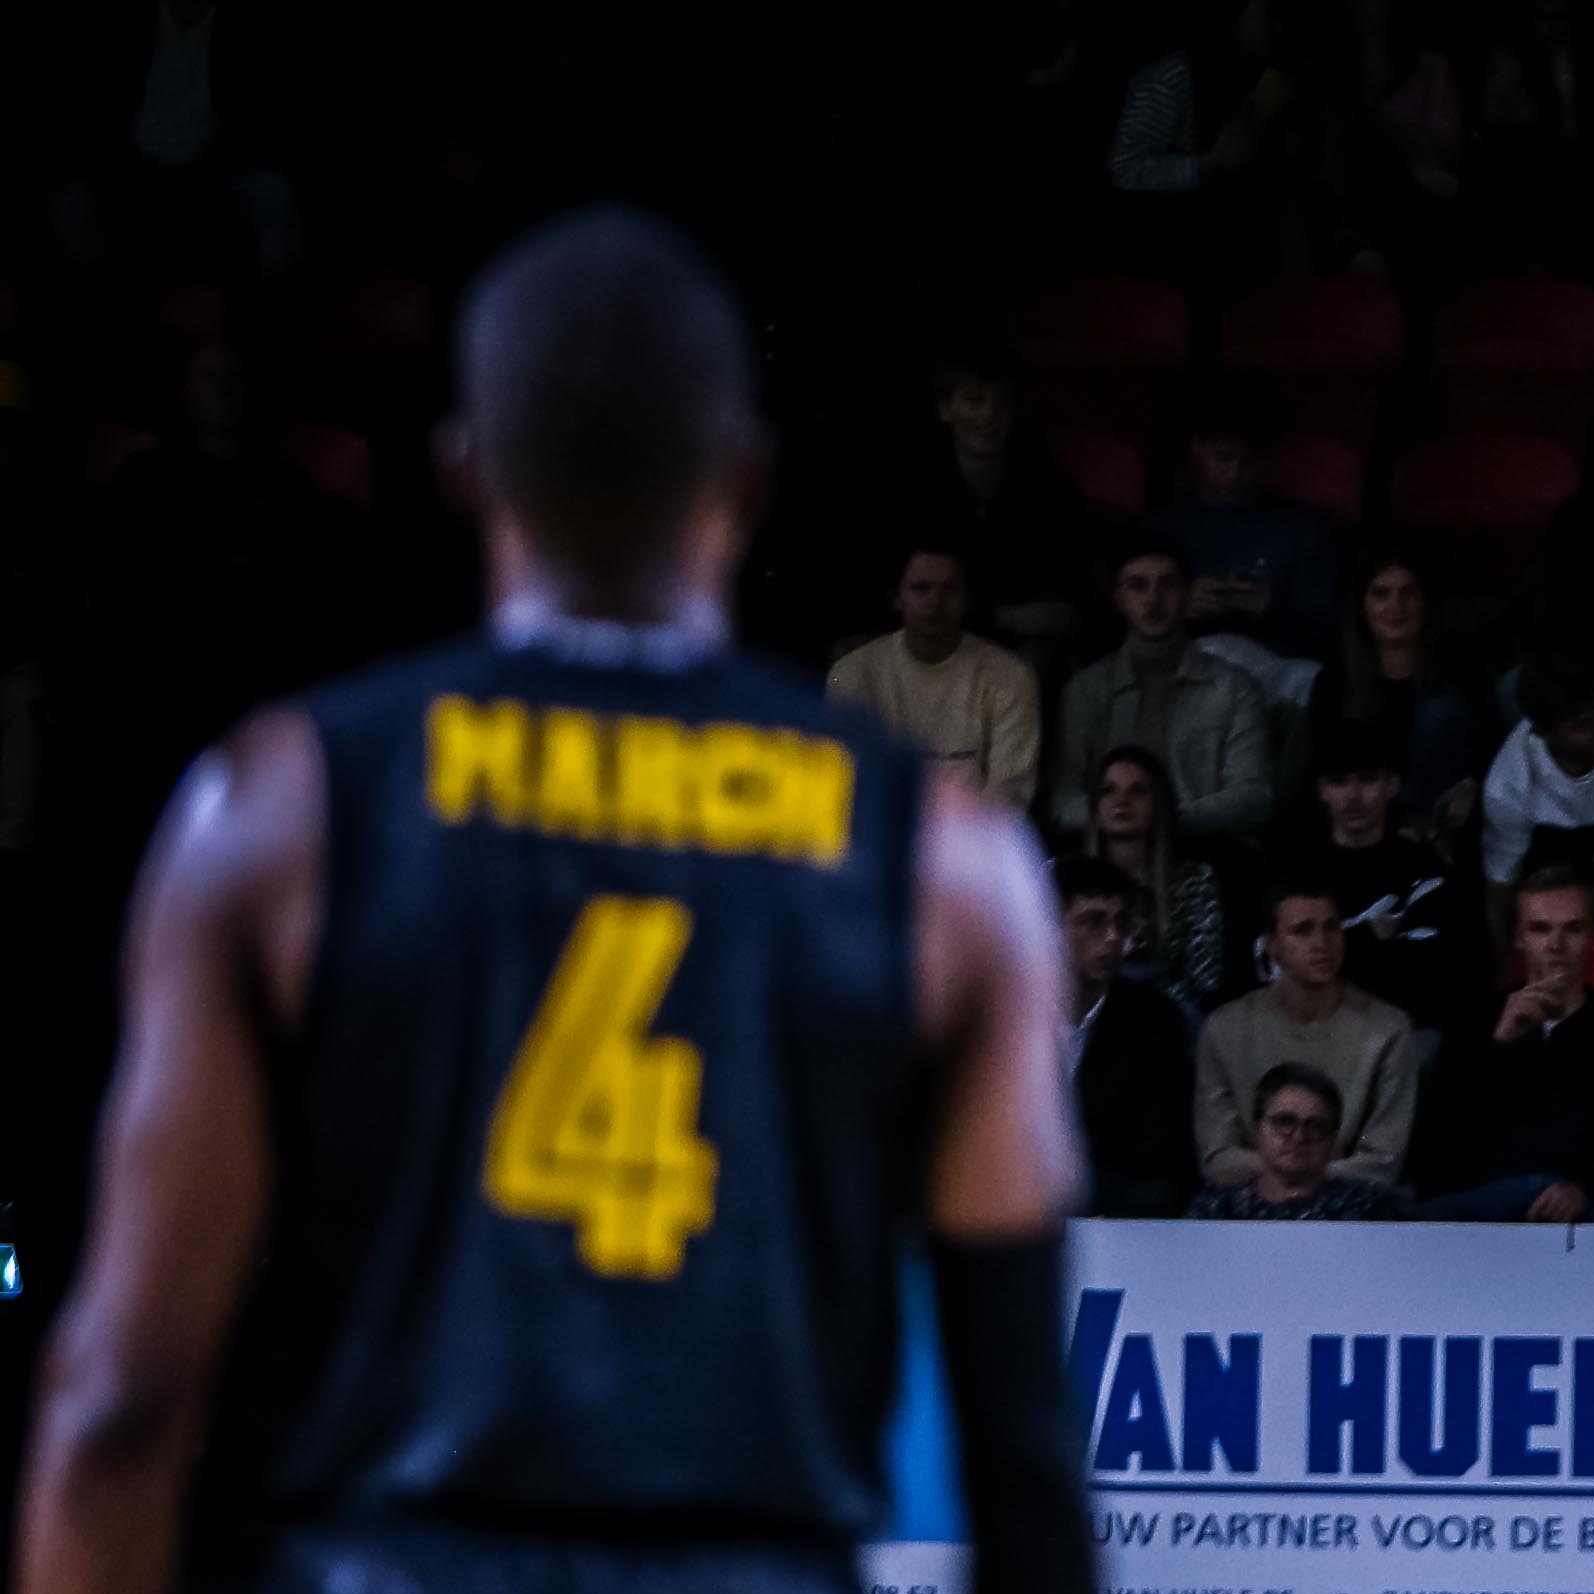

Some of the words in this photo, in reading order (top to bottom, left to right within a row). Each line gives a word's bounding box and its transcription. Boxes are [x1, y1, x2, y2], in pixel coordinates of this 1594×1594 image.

[483, 894, 719, 1280] 4
[1172, 1513, 1359, 1549] PARTNER
[1371, 1514, 1498, 1550] VOOR
[1510, 1515, 1564, 1550] DE
